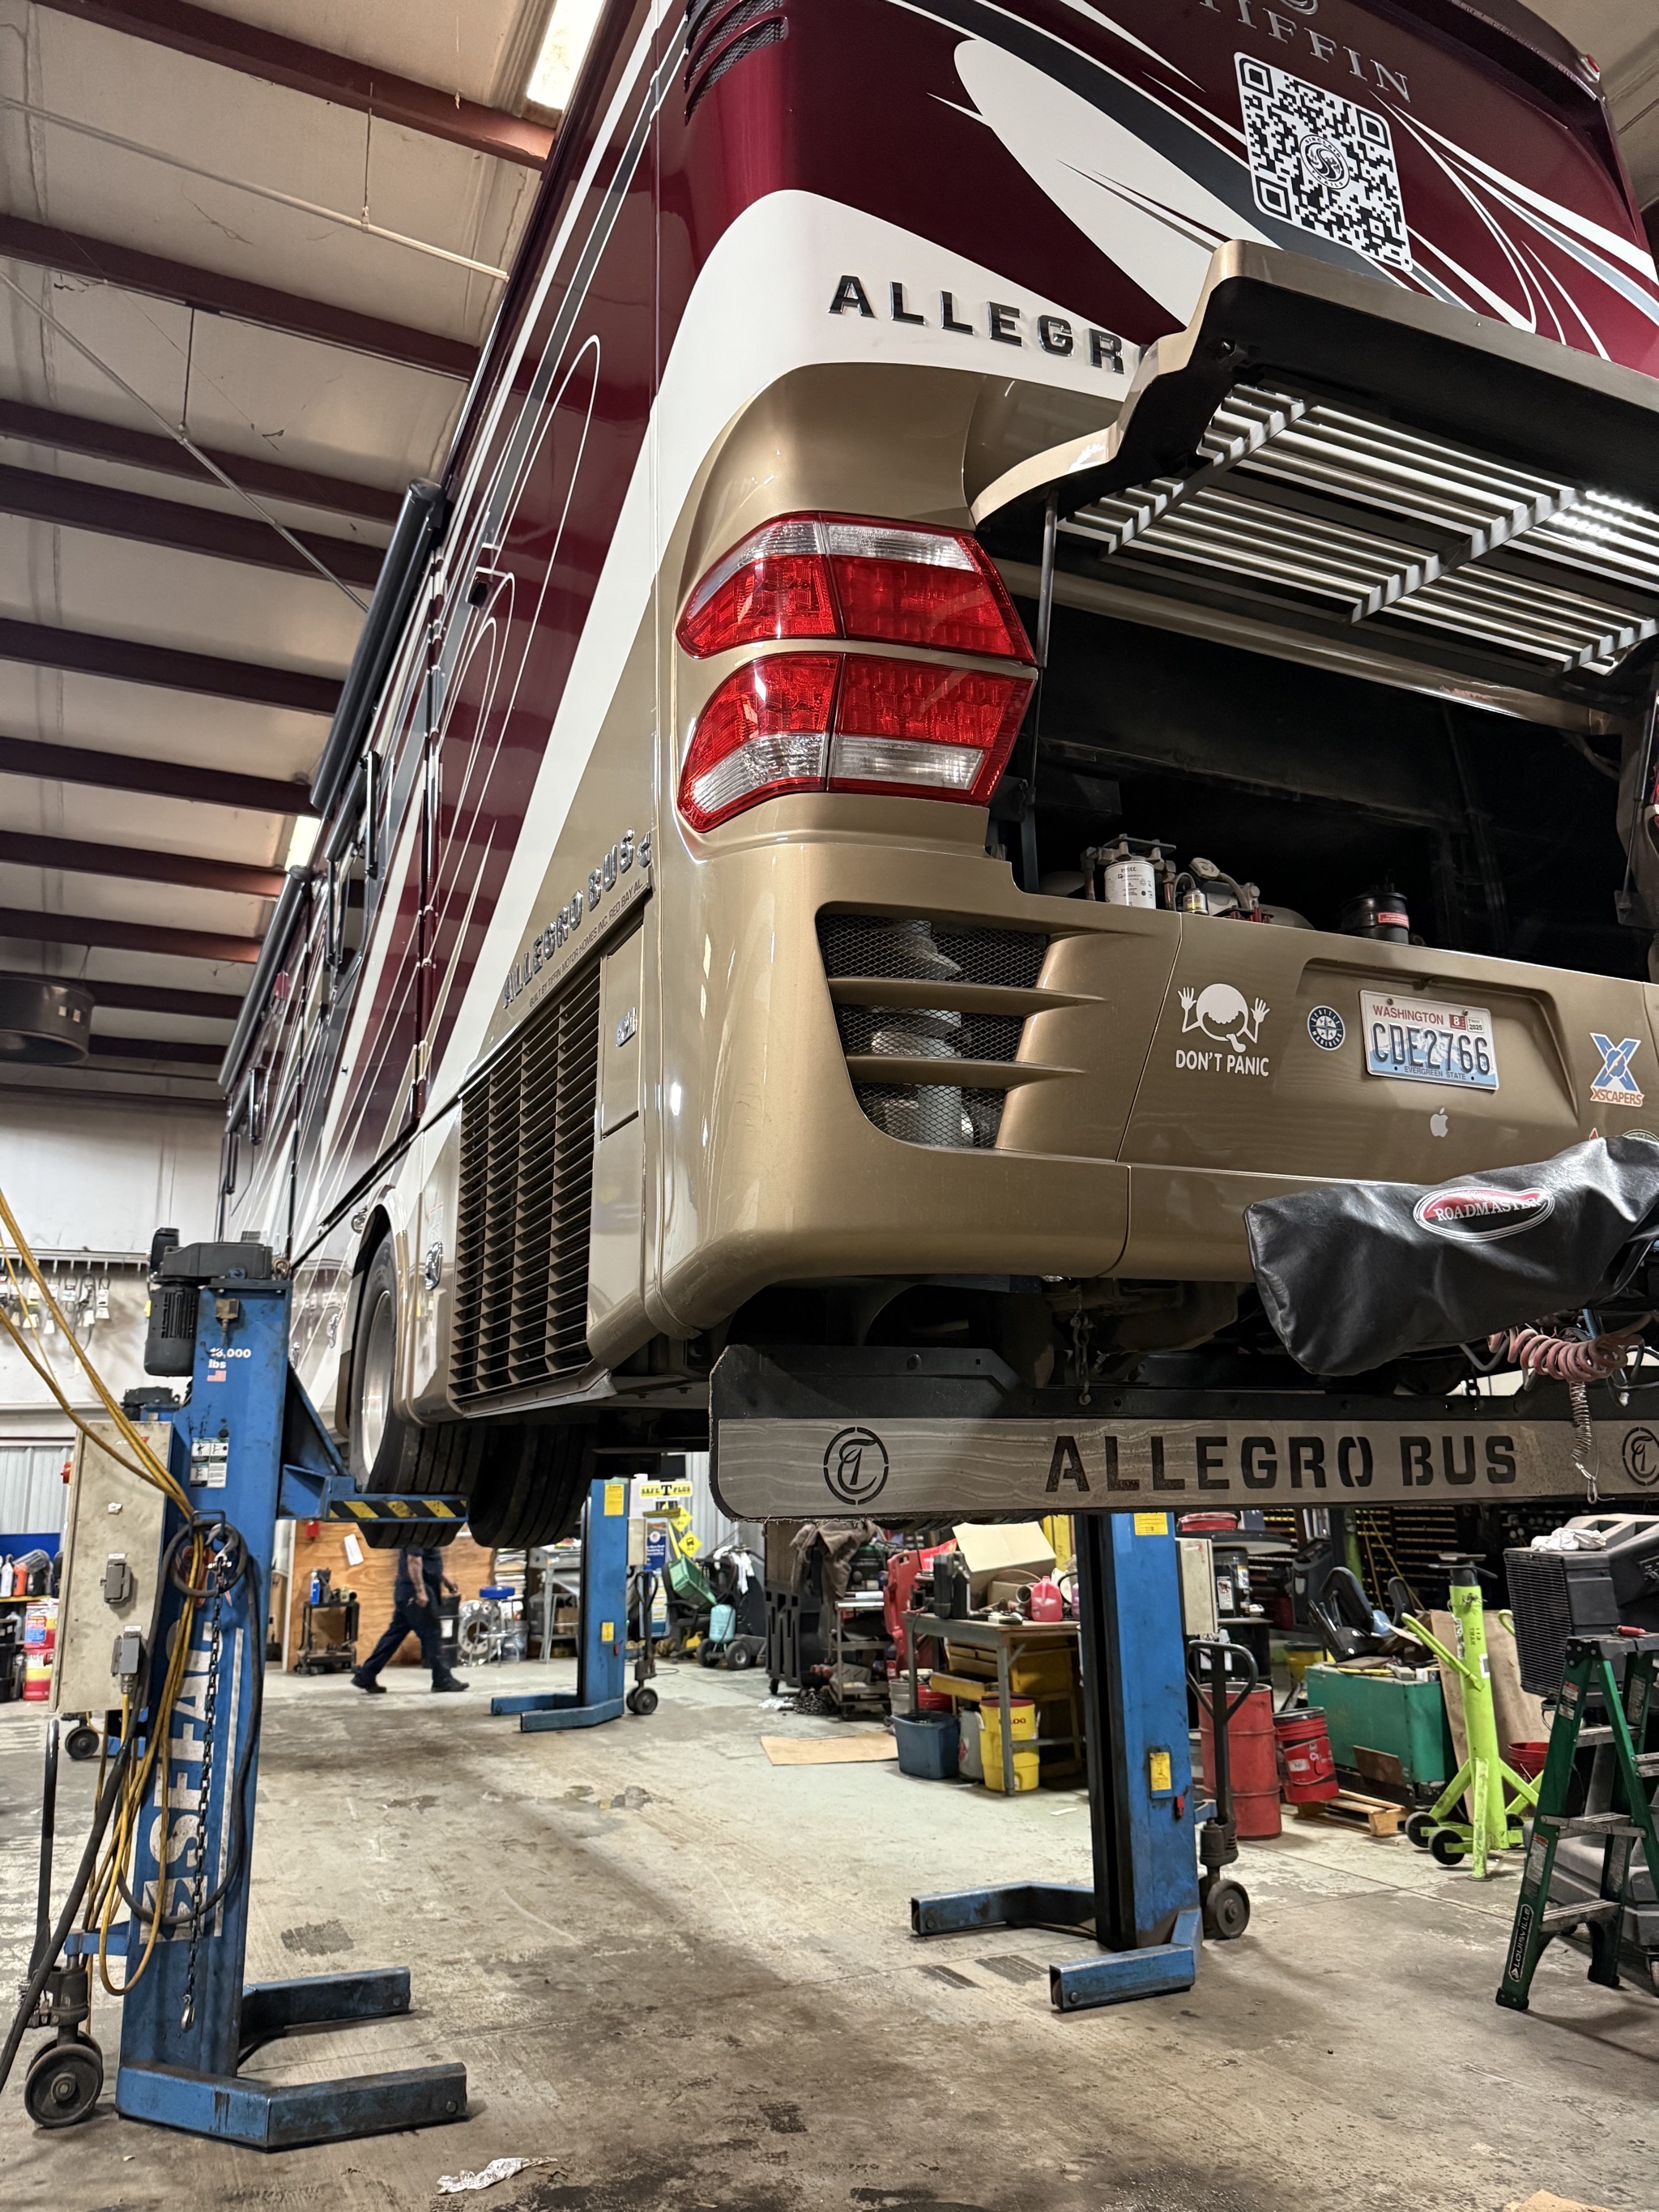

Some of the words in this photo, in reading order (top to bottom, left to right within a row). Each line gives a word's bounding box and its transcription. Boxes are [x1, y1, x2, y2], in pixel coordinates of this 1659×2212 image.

[827, 275, 1147, 375] ALLEGR
[621, 886, 633, 908] BAY
[1372, 1005, 1444, 1025] WASHINGTON
[1453, 1016, 1461, 1027] 8
[1469, 1023, 1483, 1031] 2025
[1372, 1022, 1491, 1076] CDE2766
[1226, 1053, 1269, 1077] PANIC
[1404, 1065, 1444, 1078] EVERGREEN
[1446, 1070, 1466, 1080] STATE
[1592, 1087, 1643, 1105] XSCAPERS
[1046, 1435, 1373, 1492] ALLEGRO
[1399, 1435, 1516, 1486] BUS
[1514, 1907, 1531, 1968] LOUISVILLE
